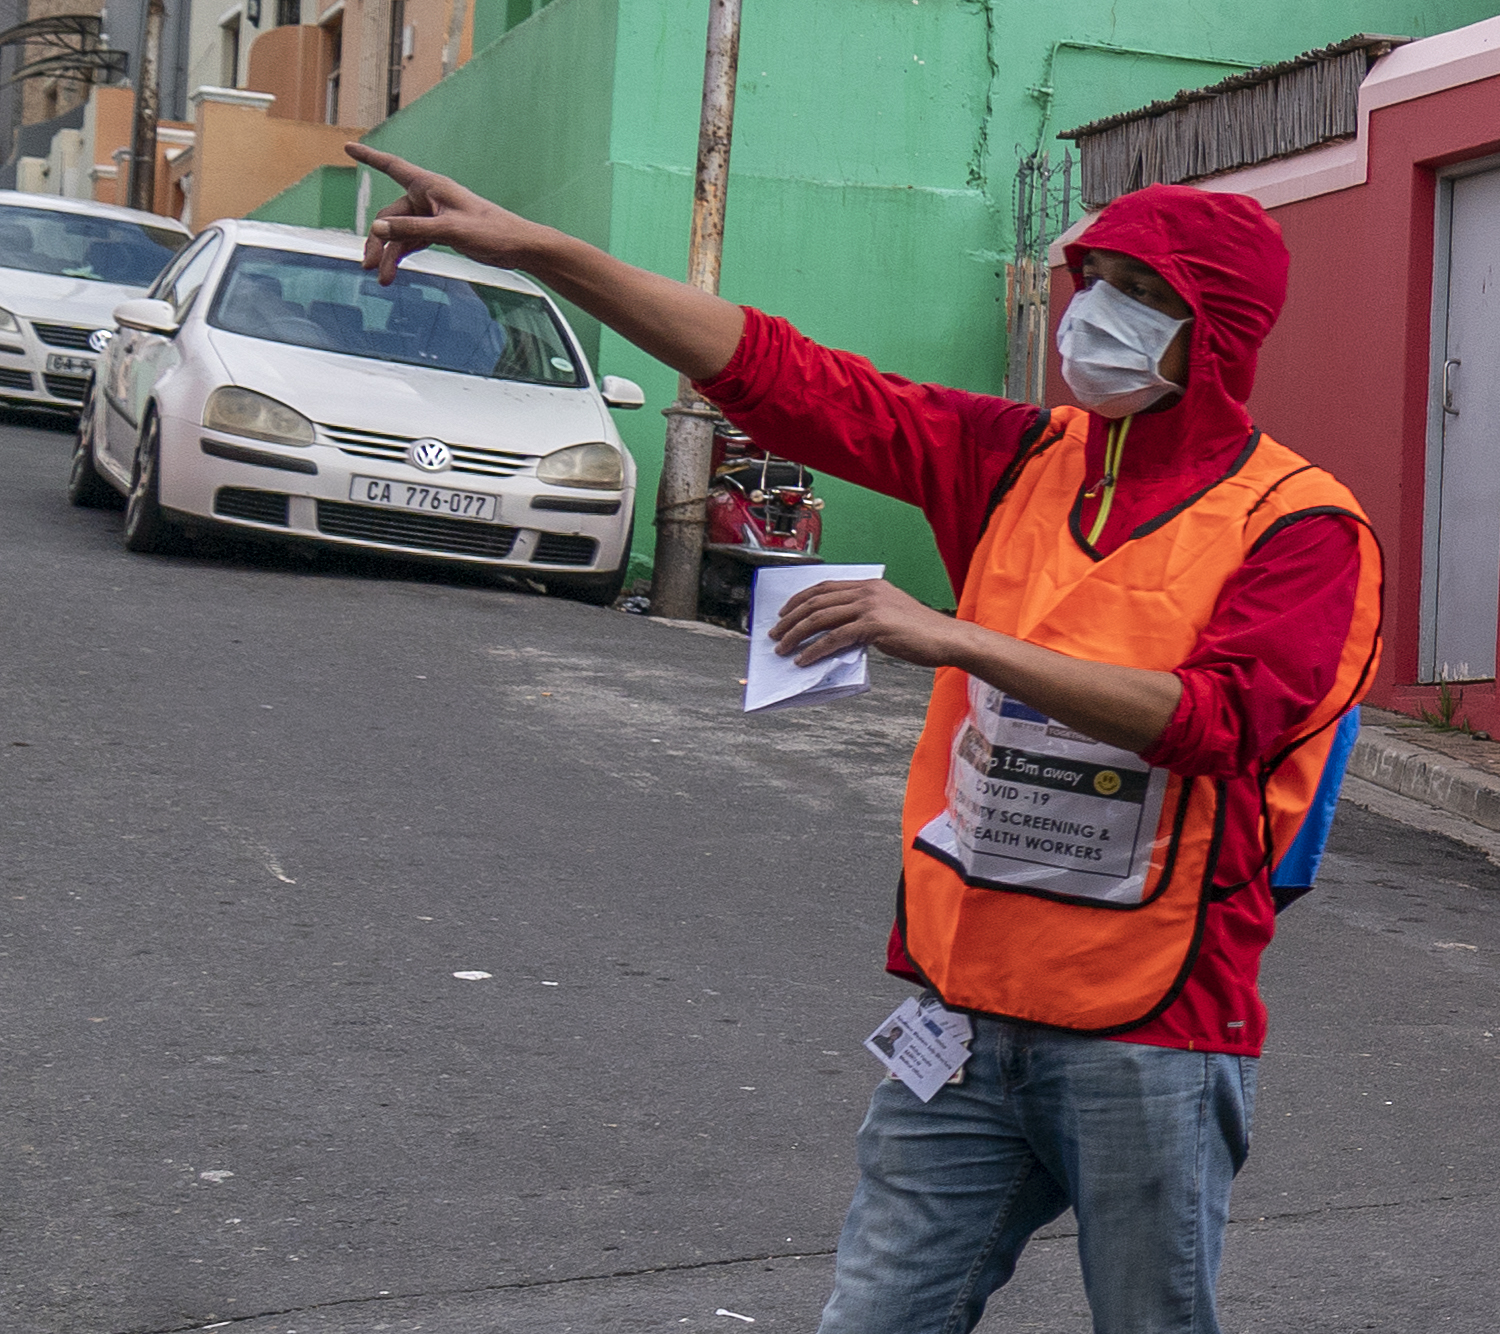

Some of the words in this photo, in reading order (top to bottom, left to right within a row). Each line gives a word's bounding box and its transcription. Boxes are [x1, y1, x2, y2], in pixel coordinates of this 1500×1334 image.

[367, 481, 391, 503] CA
[406, 486, 487, 516] 776-077
[1002, 756, 1039, 776] 1.5m
[1043, 766, 1084, 786] away
[1000, 809, 1096, 839] SCREENING
[1099, 828, 1110, 841] &
[974, 825, 1020, 847] EALTH
[1025, 835, 1103, 861] WORKERS
